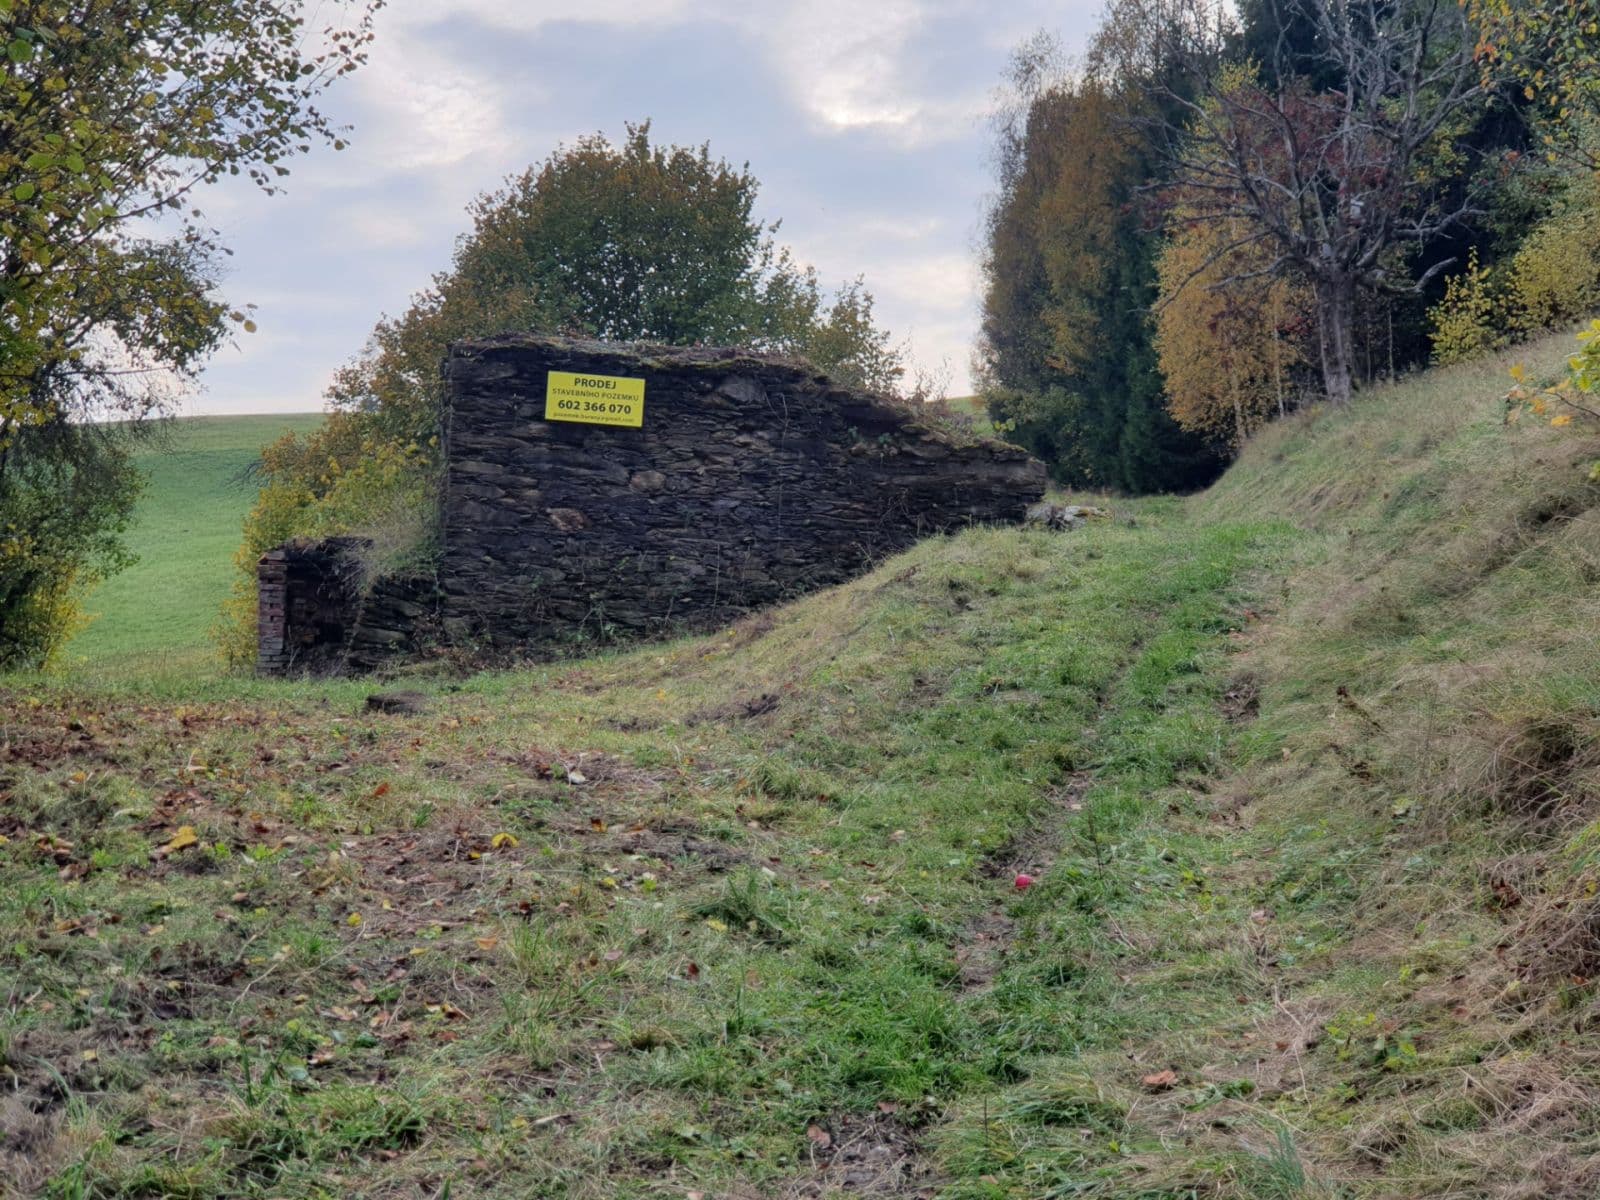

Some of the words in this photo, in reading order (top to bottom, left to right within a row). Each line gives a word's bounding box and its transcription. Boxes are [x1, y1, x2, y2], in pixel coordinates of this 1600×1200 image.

[574, 377, 617, 389] PRODEJ
[552, 388, 600, 398] STAVEBNÍHO
[601, 393, 639, 401] POZEMKU
[558, 400, 580, 410] 602
[583, 401, 606, 412] 366
[608, 404, 632, 414] 070
